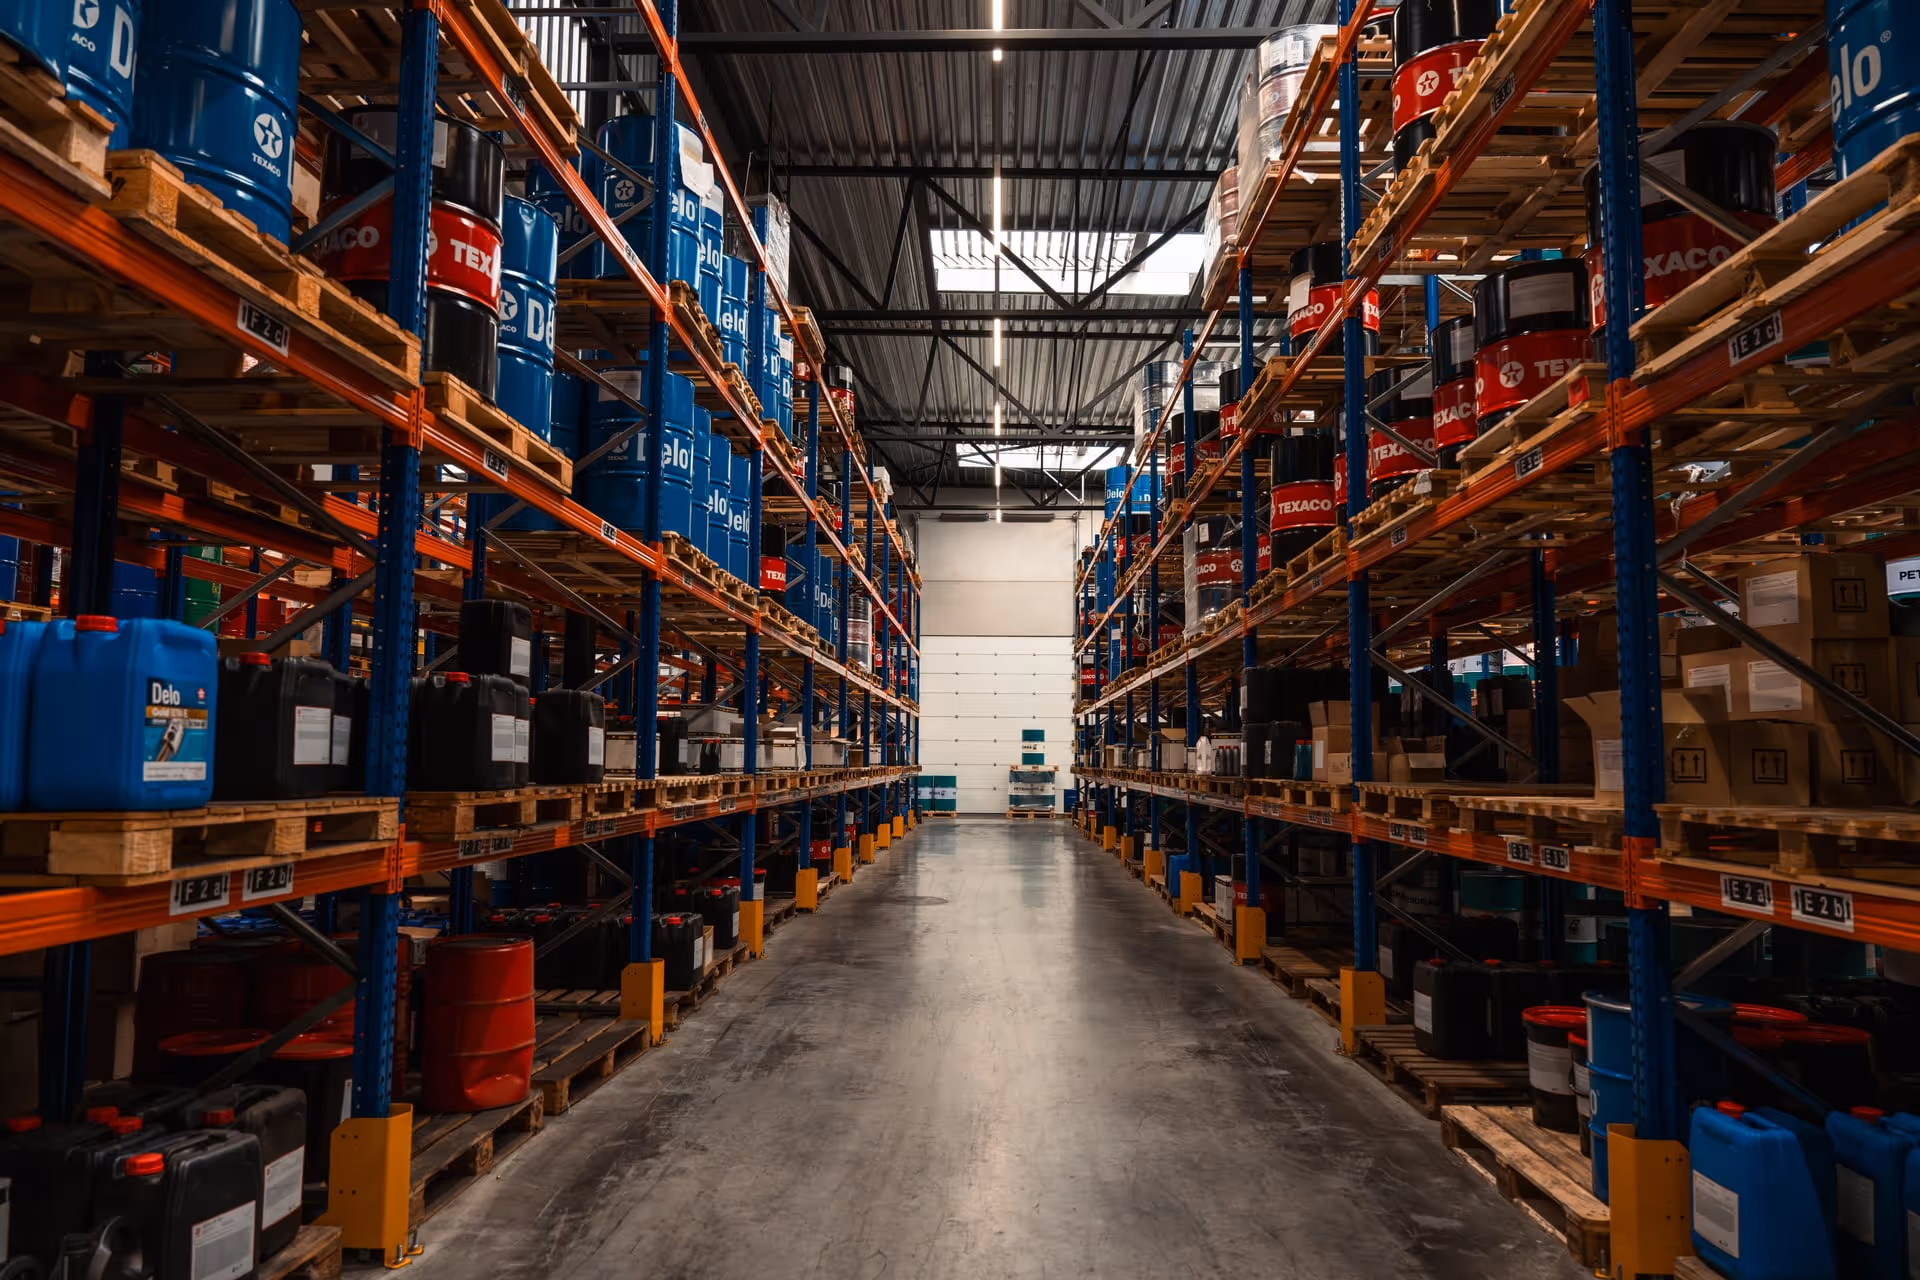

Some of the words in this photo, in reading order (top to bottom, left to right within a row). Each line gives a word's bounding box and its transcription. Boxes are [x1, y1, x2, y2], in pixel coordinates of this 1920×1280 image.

[71, 31, 96, 52] ACO
[251, 152, 281, 178] TEXACO
[550, 205, 590, 234] elo
[450, 238, 497, 278] TEX
[699, 239, 721, 270] elo
[1642, 246, 1731, 281] XACO
[1278, 499, 1333, 515] TEXACO
[152, 682, 182, 706] Delo
